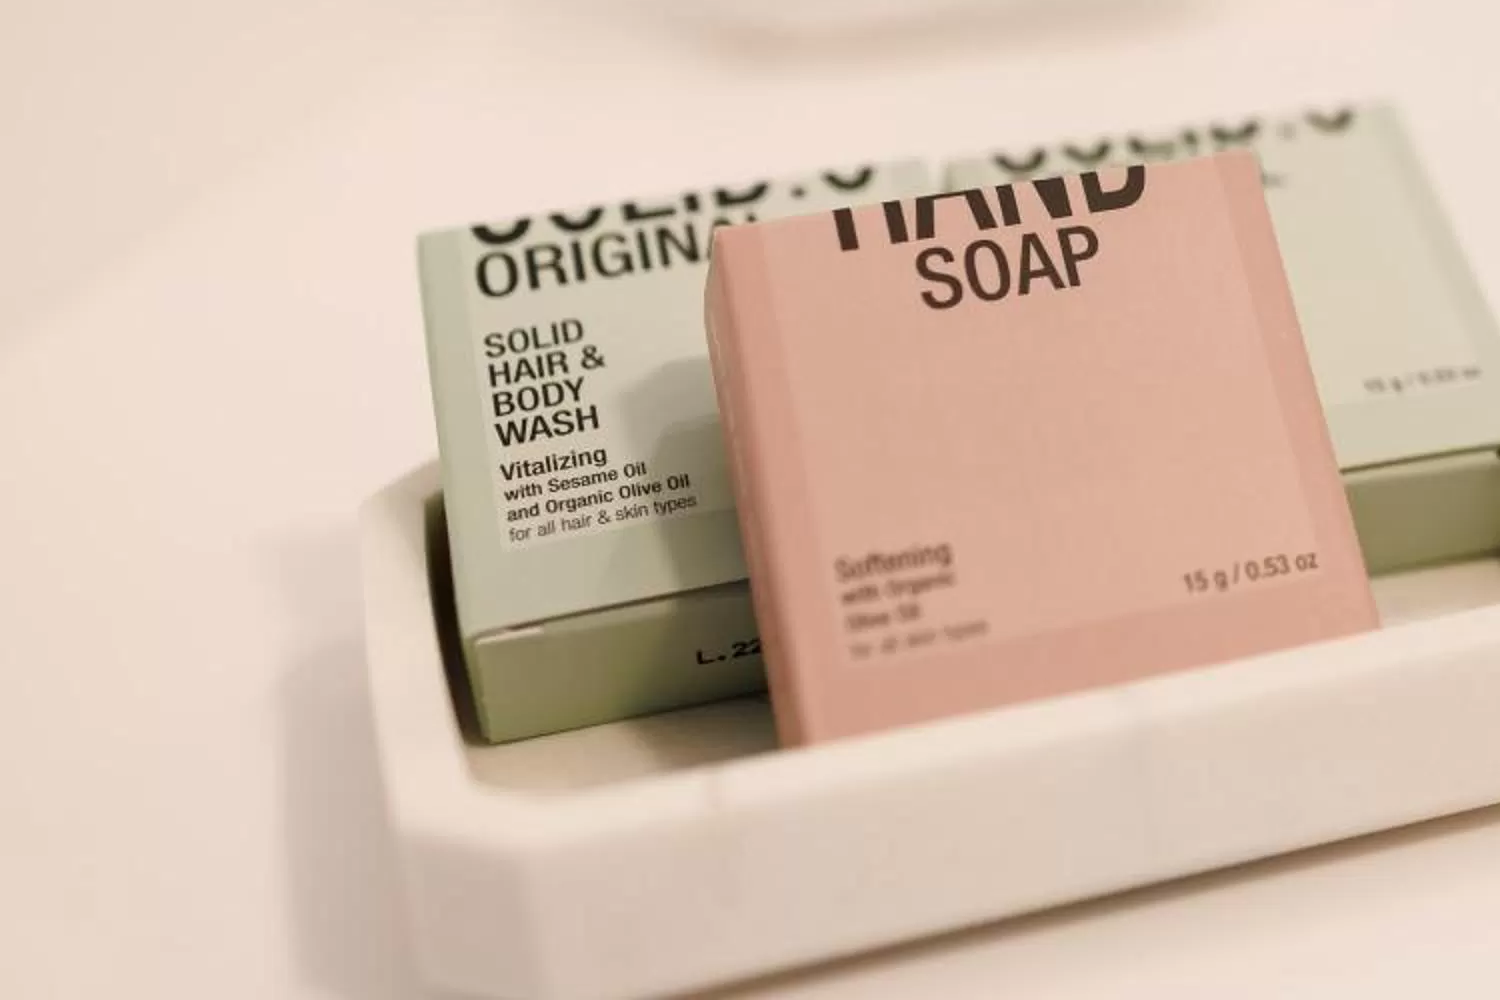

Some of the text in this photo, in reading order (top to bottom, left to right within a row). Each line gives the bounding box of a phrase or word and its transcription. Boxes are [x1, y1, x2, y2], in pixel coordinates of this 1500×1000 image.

[475, 213, 757, 298] ORIGIN
[915, 225, 1099, 310] SOAP
[483, 318, 584, 358] SOLID
[488, 344, 605, 388] HAIR &
[491, 376, 585, 418] BODY
[494, 404, 600, 448] WASH
[500, 449, 608, 481] Vitalizing
[504, 461, 648, 501] with Sesame Oil
[507, 473, 691, 522] and Organic Olive Oil
[509, 495, 698, 542] for all hair & skin types
[1183, 569, 1209, 594] 15
[1244, 553, 1291, 582] 0.53
[1295, 552, 1319, 572] oz
